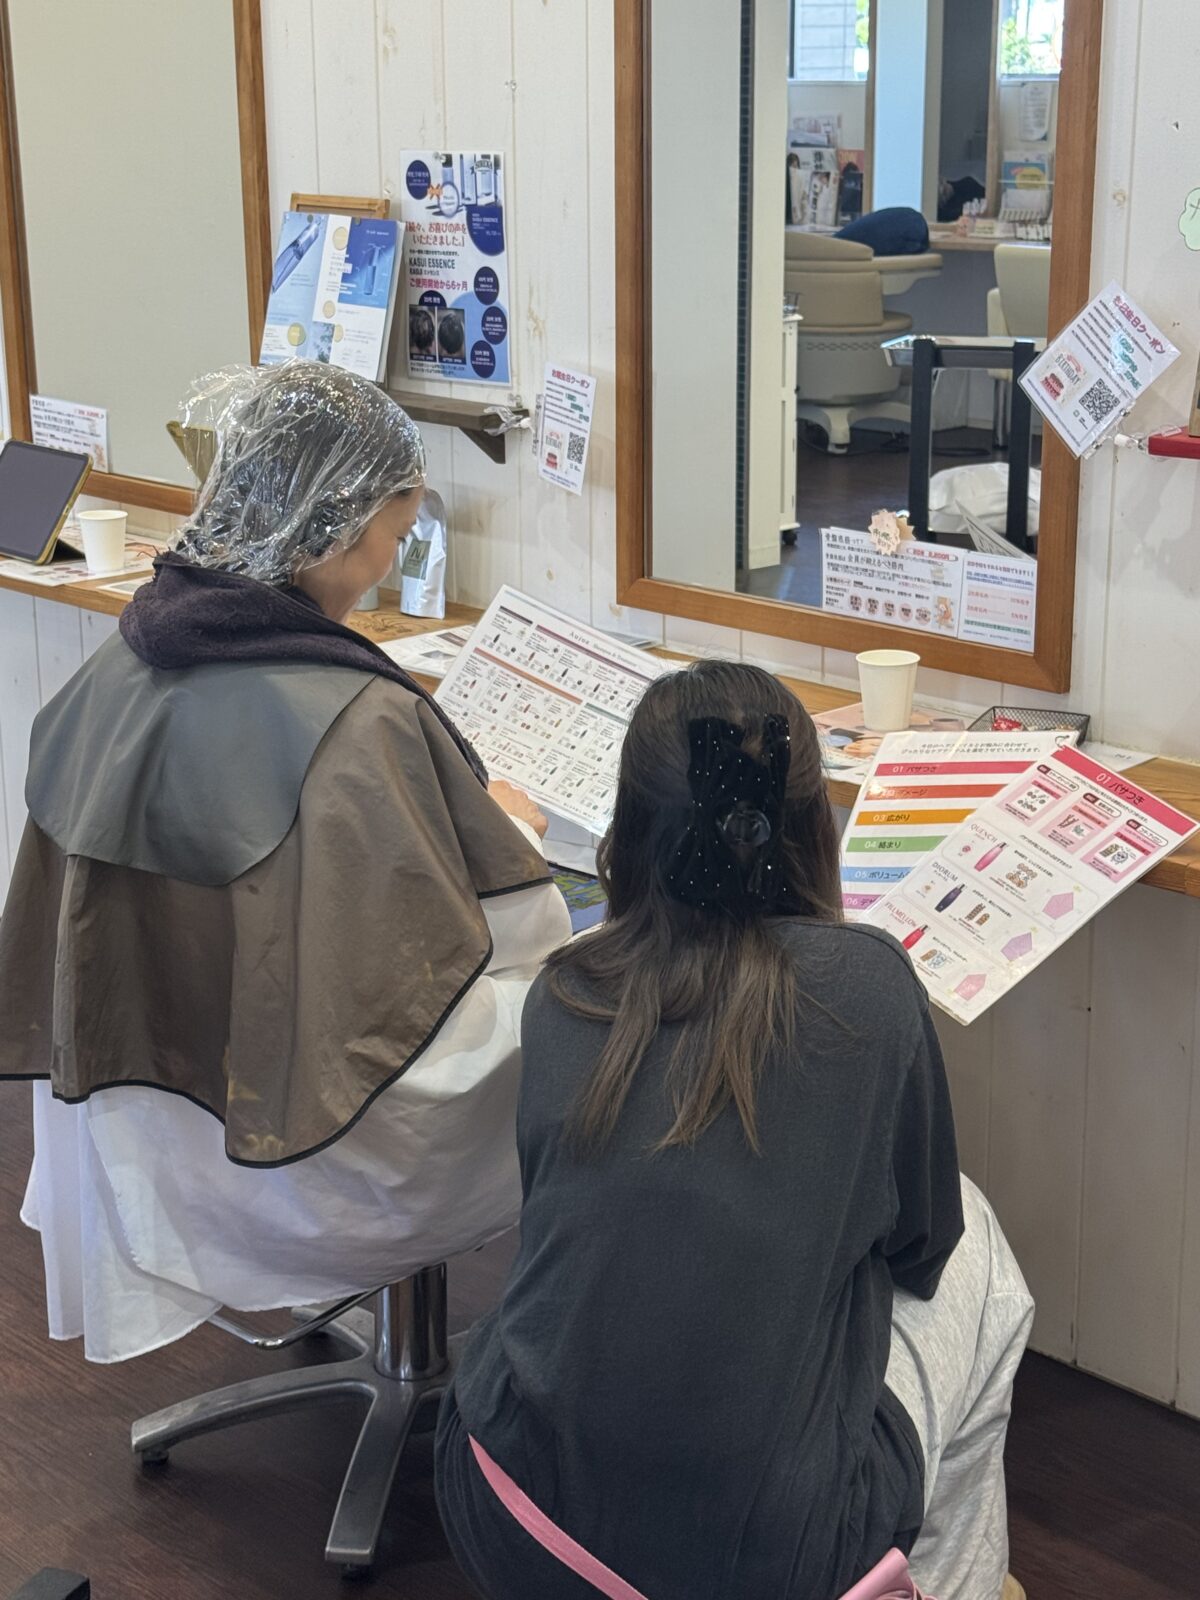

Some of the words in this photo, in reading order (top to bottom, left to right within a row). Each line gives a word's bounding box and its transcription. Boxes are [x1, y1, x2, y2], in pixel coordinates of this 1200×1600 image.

[409, 257, 427, 267] KASUI
[428, 258, 455, 269] ESSENCE
[1054, 353, 1082, 386] BIRTHDAY
[892, 765, 904, 773] 01
[1096, 772, 1111, 785] 01
[1109, 781, 1146, 806] パサつき
[873, 814, 886, 822] 03
[886, 814, 911, 822] 広がり
[864, 841, 877, 849] 04
[931, 861, 959, 882] DIORUM
[846, 897, 858, 905] 06
